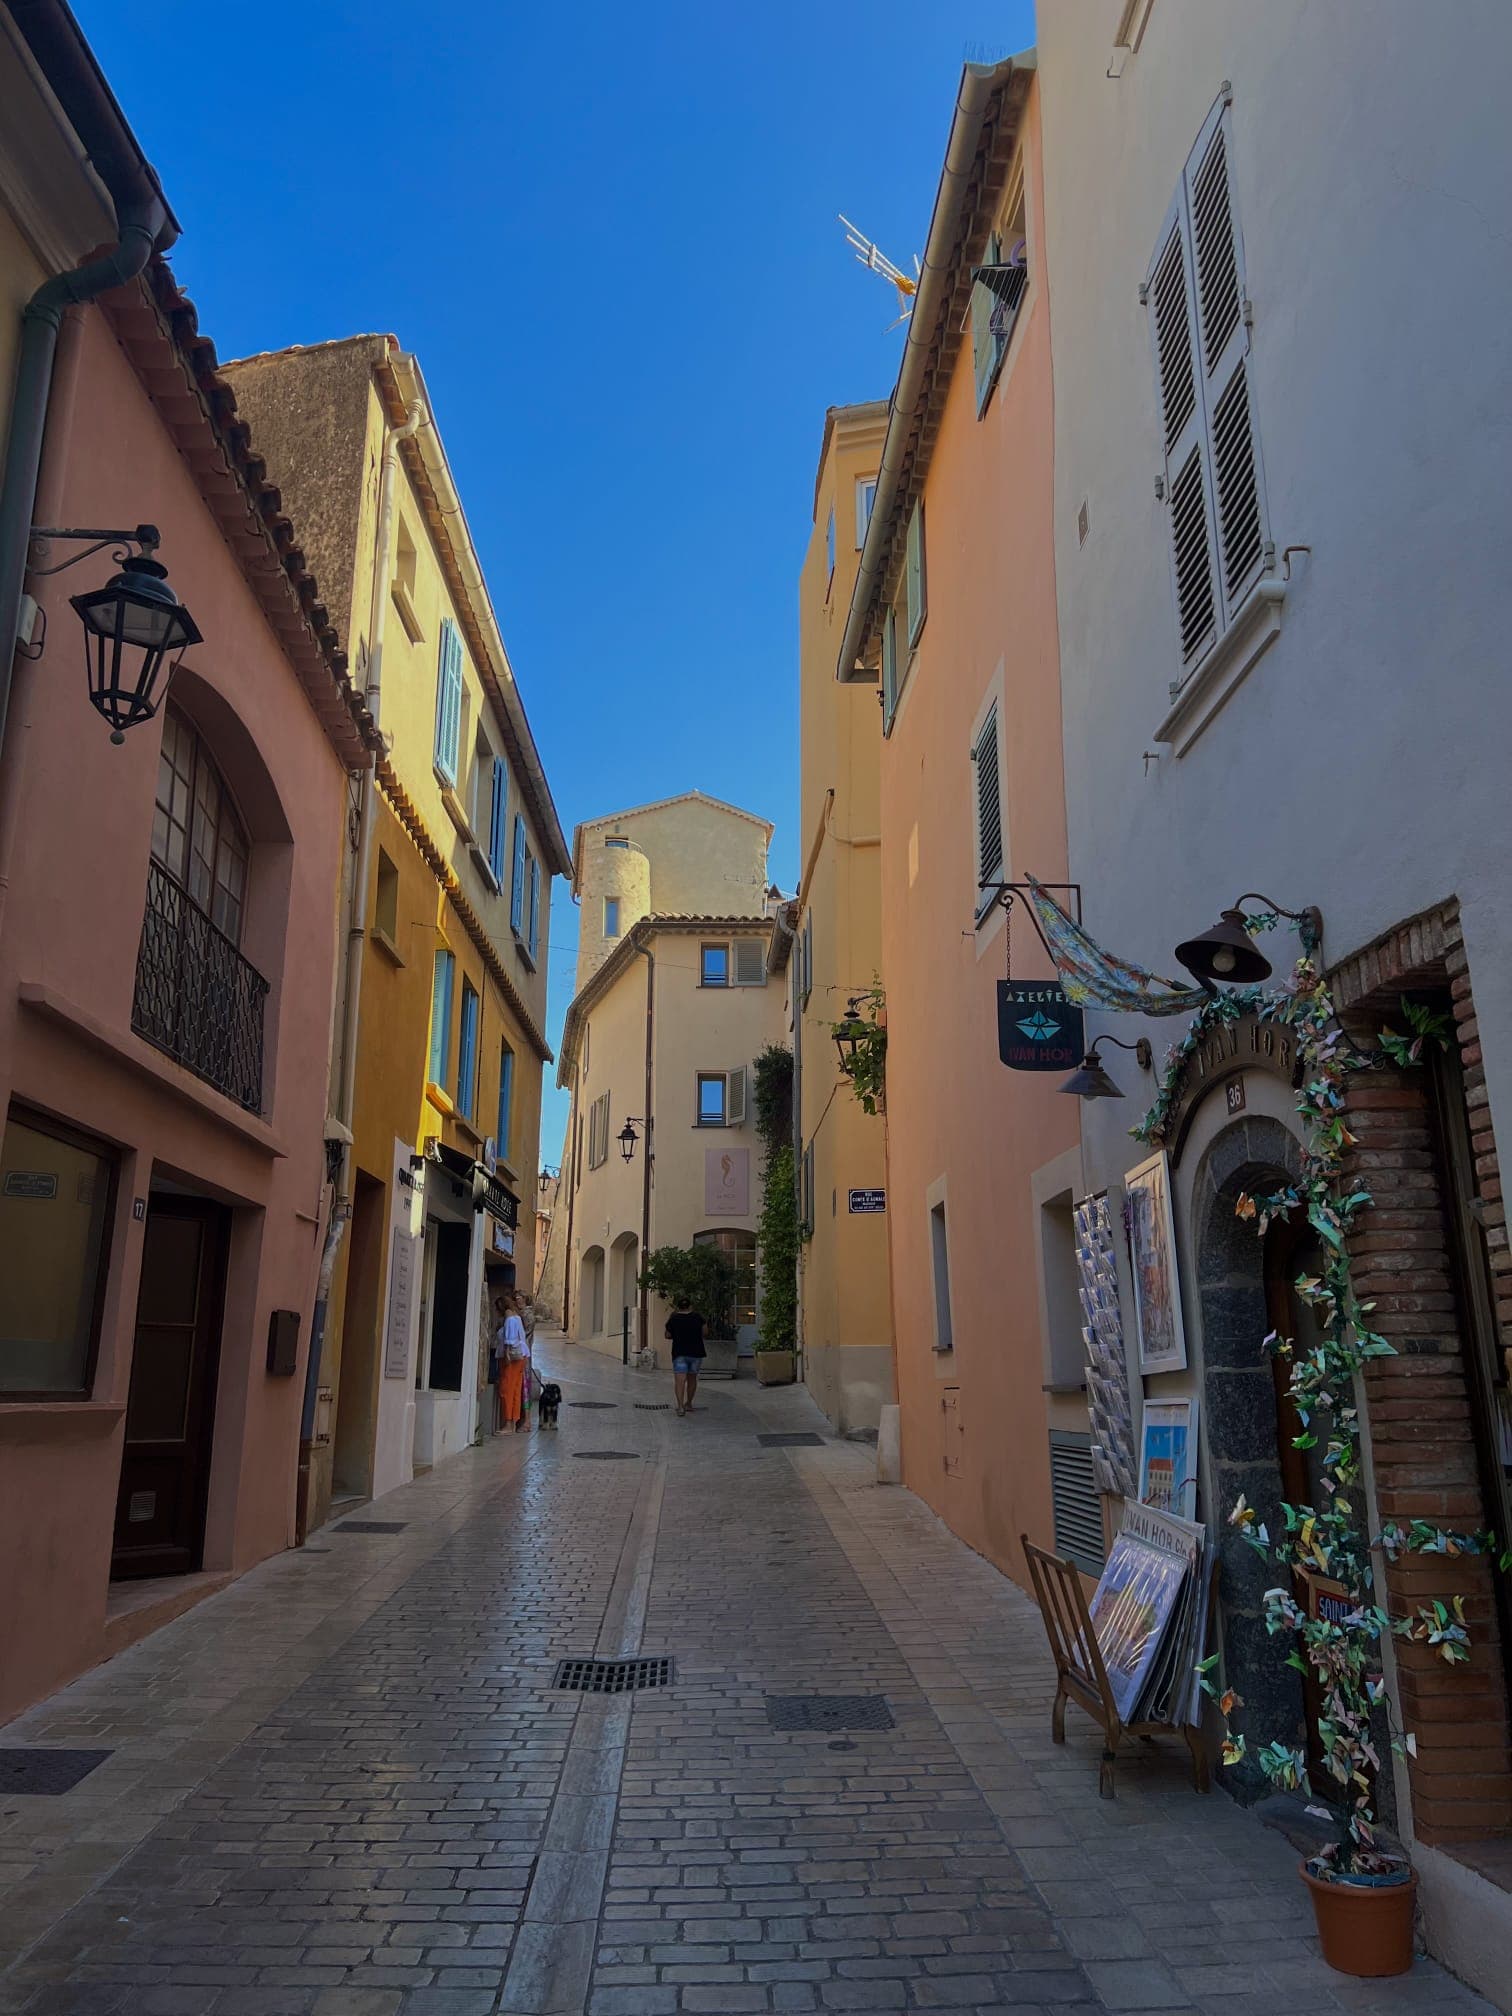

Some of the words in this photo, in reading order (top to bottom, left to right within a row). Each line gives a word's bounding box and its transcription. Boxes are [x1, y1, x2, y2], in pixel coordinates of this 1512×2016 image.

[1008, 1048, 1036, 1061] IVAN
[1039, 1048, 1073, 1062] HOR
[1199, 1028, 1238, 1078] IVAN
[1251, 1025, 1289, 1068] HOR
[1229, 1085, 1241, 1108] 36
[135, 1203, 143, 1217] 17
[1126, 1509, 1149, 1540] IVAN
[1152, 1523, 1172, 1550] HOR
